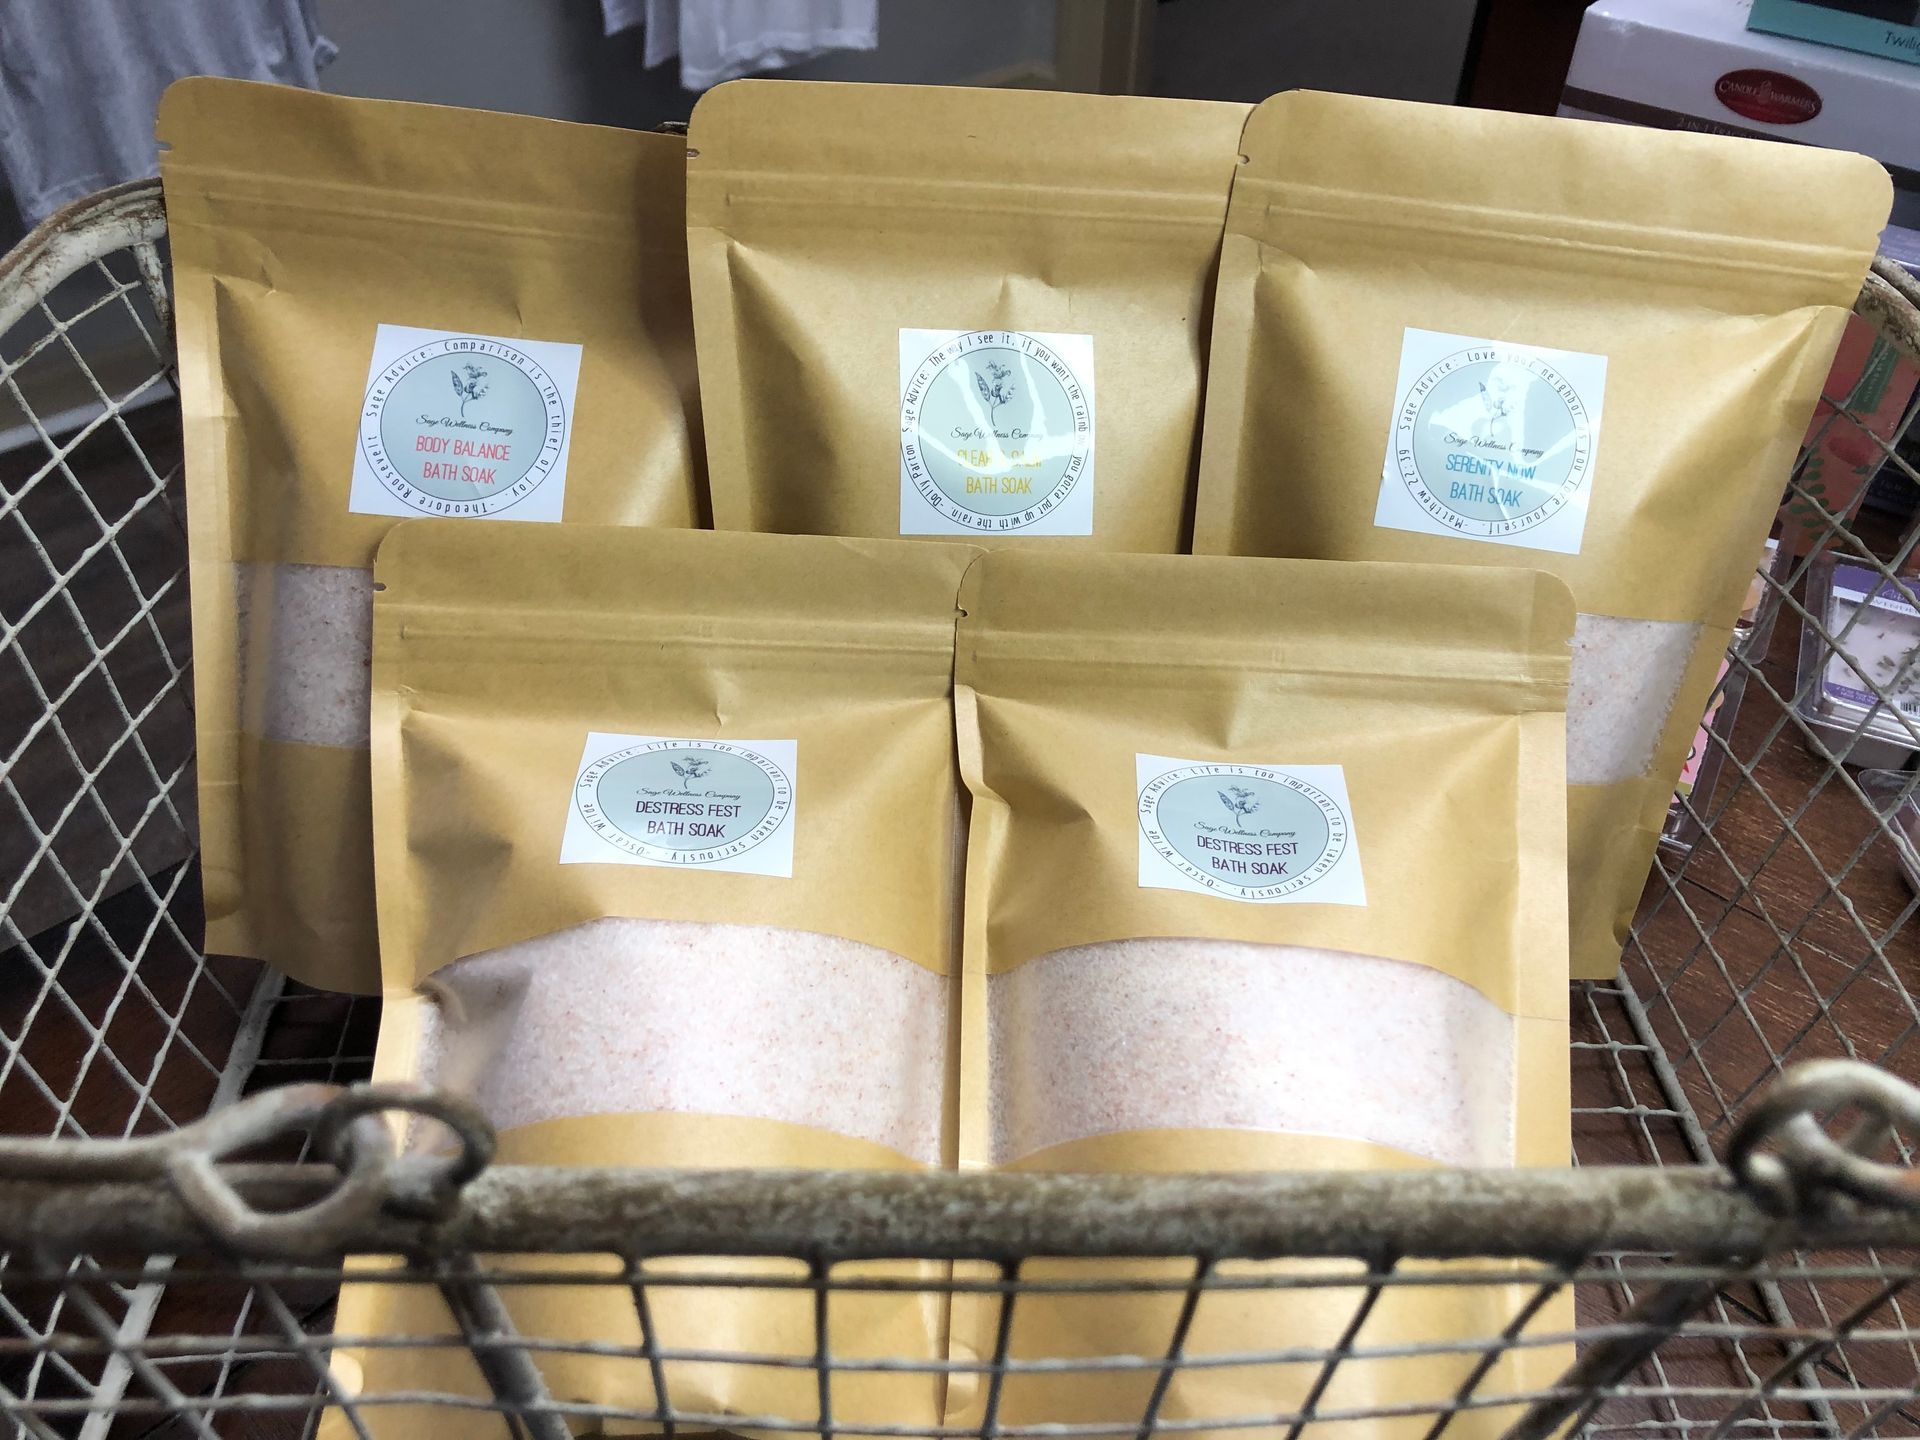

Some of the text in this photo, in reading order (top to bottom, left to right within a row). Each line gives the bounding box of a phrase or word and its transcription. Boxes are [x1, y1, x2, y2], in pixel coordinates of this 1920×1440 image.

[1770, 90, 1817, 114] WARMERS
[977, 334, 994, 345] see
[1022, 337, 1033, 351] if
[444, 341, 525, 365] Comparison
[929, 351, 947, 368] The
[1035, 346, 1051, 363] you
[1467, 351, 1496, 362] Love
[384, 348, 435, 383] Advice:
[529, 366, 542, 380] is
[1050, 359, 1070, 382] want
[906, 369, 931, 406] Advice:
[1415, 359, 1459, 396] Advice:
[543, 386, 557, 406] the
[1067, 383, 1081, 401] the
[1541, 368, 1582, 417] neighbor
[366, 389, 386, 417] Sage
[415, 414, 513, 436] Sage Wellness Company
[1400, 402, 1417, 431] Sage
[546, 415, 562, 451] thief
[950, 426, 973, 441] Sage
[973, 427, 1009, 439] Wllness
[1444, 432, 1468, 448] Sage
[1471, 435, 1506, 450] Wellness
[415, 436, 512, 461] BODY BALANCE
[367, 435, 411, 499] Roosevelt
[535, 459, 549, 475] of
[906, 444, 923, 479] Parton
[1071, 455, 1083, 473] you
[1399, 449, 1419, 486] 22:39
[1445, 453, 1504, 476] SERENITY
[1574, 448, 1586, 471] you
[423, 462, 498, 485] BATH SOAK
[505, 476, 536, 497] joy.
[919, 479, 944, 507] -Dolly
[966, 476, 1032, 494] BATH SOAK
[1054, 474, 1074, 500] gotta
[1449, 481, 1523, 508] BATH SOAK
[951, 507, 973, 524] rain.
[1024, 510, 1035, 522] up
[1038, 498, 1053, 515] put
[1417, 490, 1468, 529] -Matthew
[976, 517, 992, 529] the
[999, 516, 1021, 529] with
[1482, 506, 1547, 535] yourself.
[647, 741, 678, 751] Life
[688, 740, 702, 748] is
[713, 743, 733, 752] too
[739, 750, 784, 783] important
[579, 770, 599, 788] Sage
[636, 787, 741, 801] Sage Wellness Company
[777, 786, 788, 796] to
[635, 800, 742, 818] DESTRESS FEST
[776, 799, 789, 811] be
[583, 802, 607, 832] Wilde
[647, 820, 726, 839] BATH SOAK
[750, 815, 780, 841] taken
[1140, 765, 1345, 900] Sage Advice: Life is too important to be taken seriously. -Oscar Wilde
[1193, 821, 1296, 839] Sage Wellness Company
[1197, 835, 1299, 856] DESTRESS FEST
[1211, 856, 1289, 875] BATH SOAK
